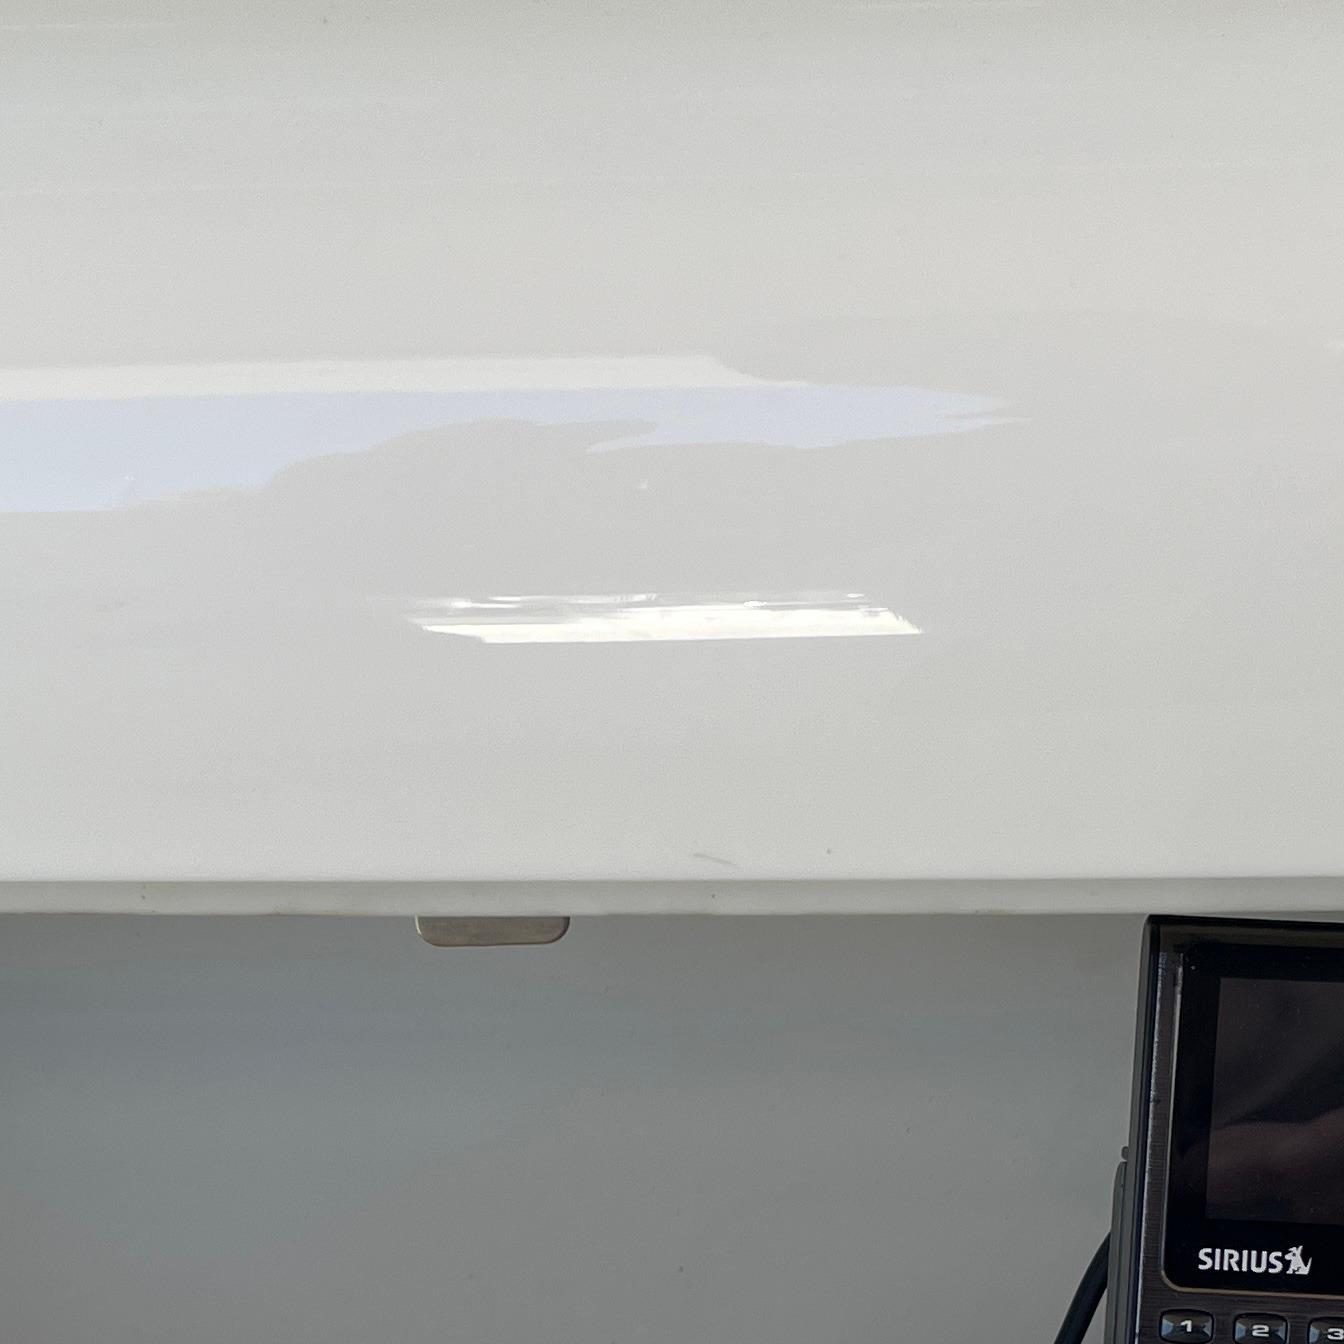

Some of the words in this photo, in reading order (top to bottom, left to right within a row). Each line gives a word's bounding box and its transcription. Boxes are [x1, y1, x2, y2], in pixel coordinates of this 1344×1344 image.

[1197, 1247, 1284, 1274] SIRIUS
[1179, 1319, 1193, 1333] 1
[1251, 1324, 1270, 1337] 2
[1326, 1327, 1344, 1341] 3
